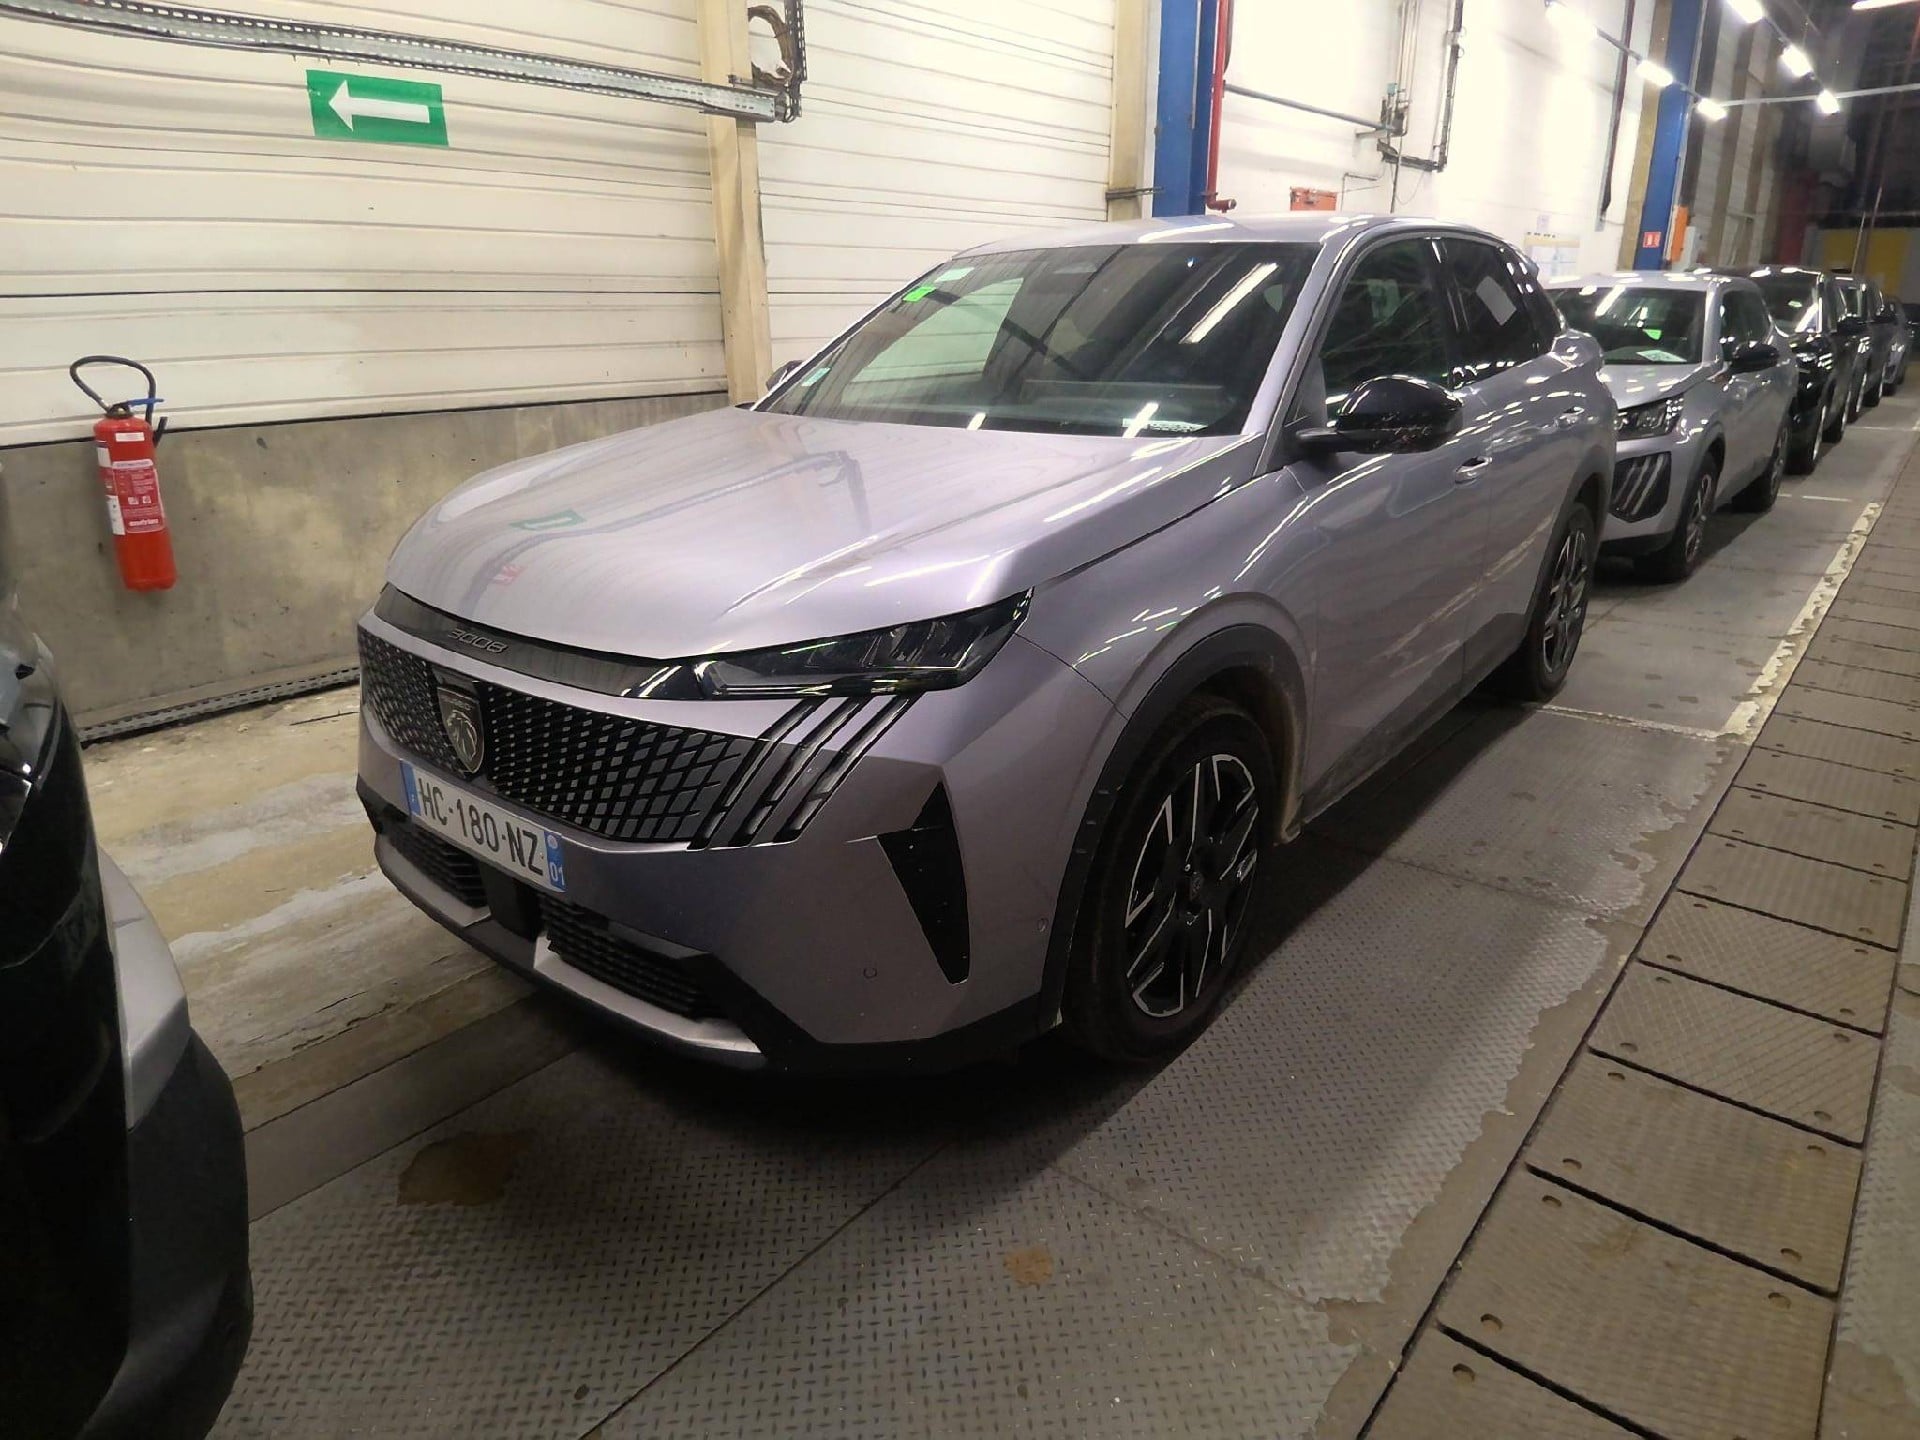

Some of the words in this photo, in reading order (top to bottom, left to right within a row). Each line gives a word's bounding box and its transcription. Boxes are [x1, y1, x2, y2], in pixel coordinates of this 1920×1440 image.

[448, 628, 508, 654] 3008
[418, 777, 544, 876] HC-180-NZ
[549, 861, 566, 887] 01
